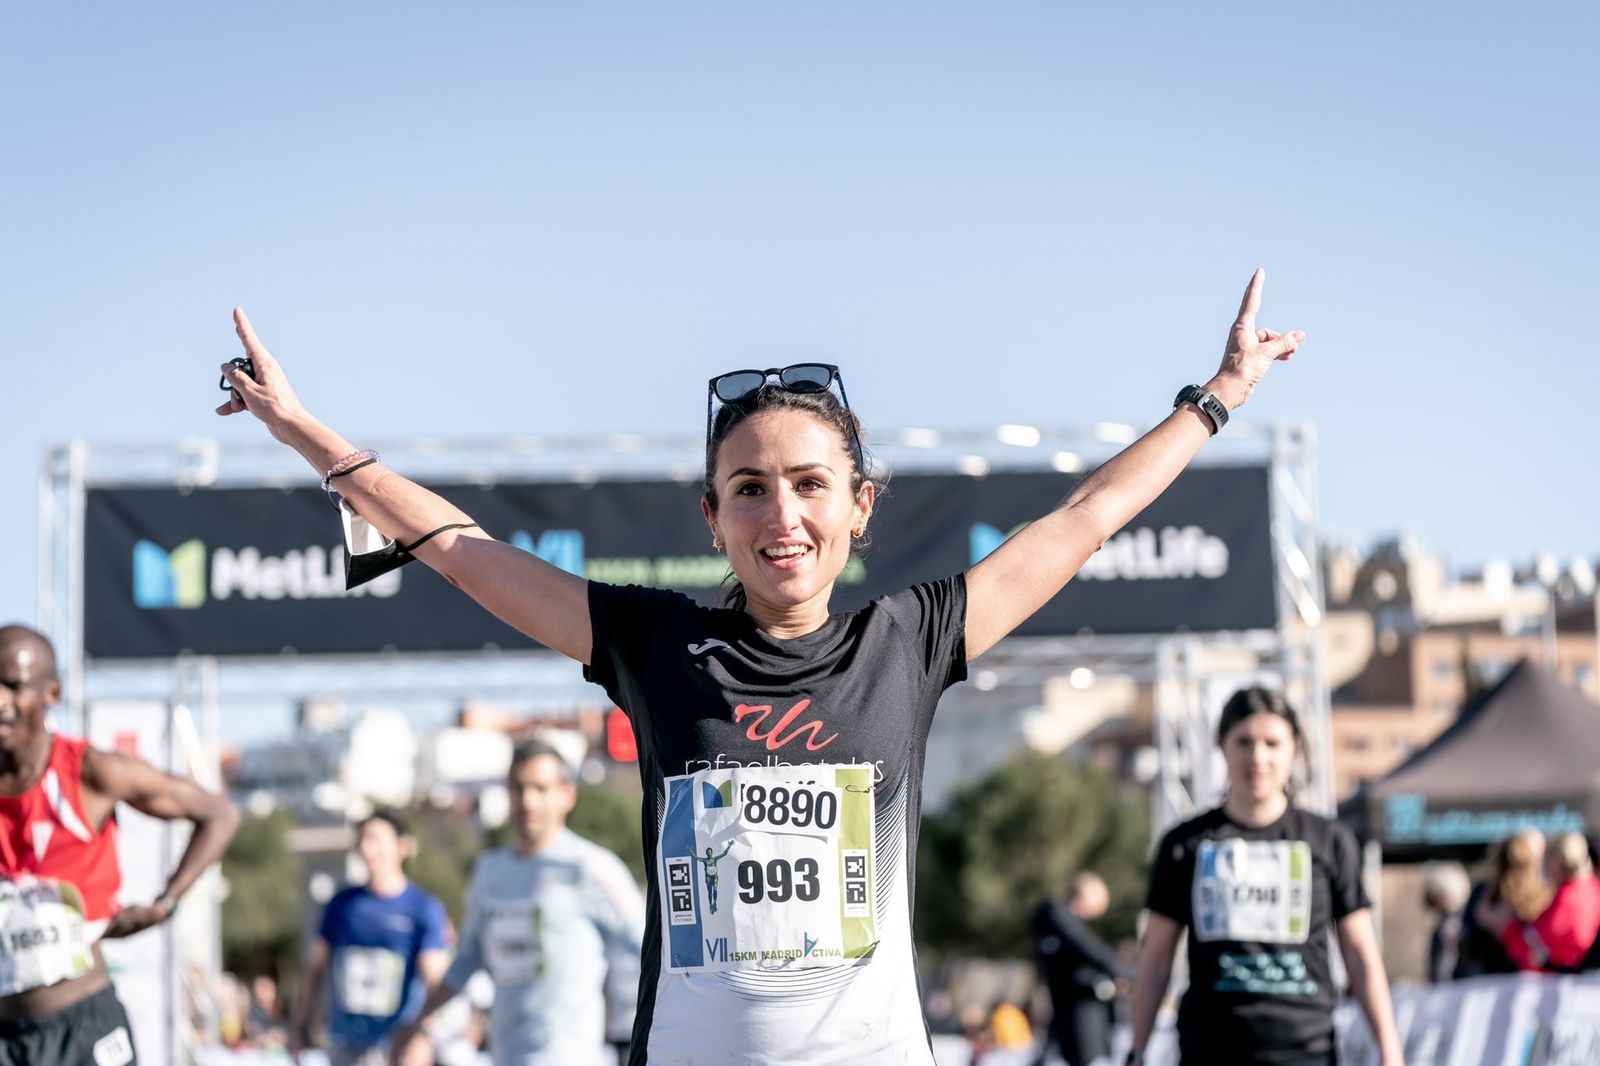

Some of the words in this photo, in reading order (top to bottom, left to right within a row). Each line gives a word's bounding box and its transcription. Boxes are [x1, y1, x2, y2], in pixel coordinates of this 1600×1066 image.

[211, 545, 402, 600] MetLi
[1077, 525, 1229, 581] etLife
[744, 785, 837, 829] 8890
[737, 858, 820, 904] 993
[705, 938, 728, 962] VII
[729, 951, 757, 961] 15KM
[761, 949, 803, 960] MADRID
